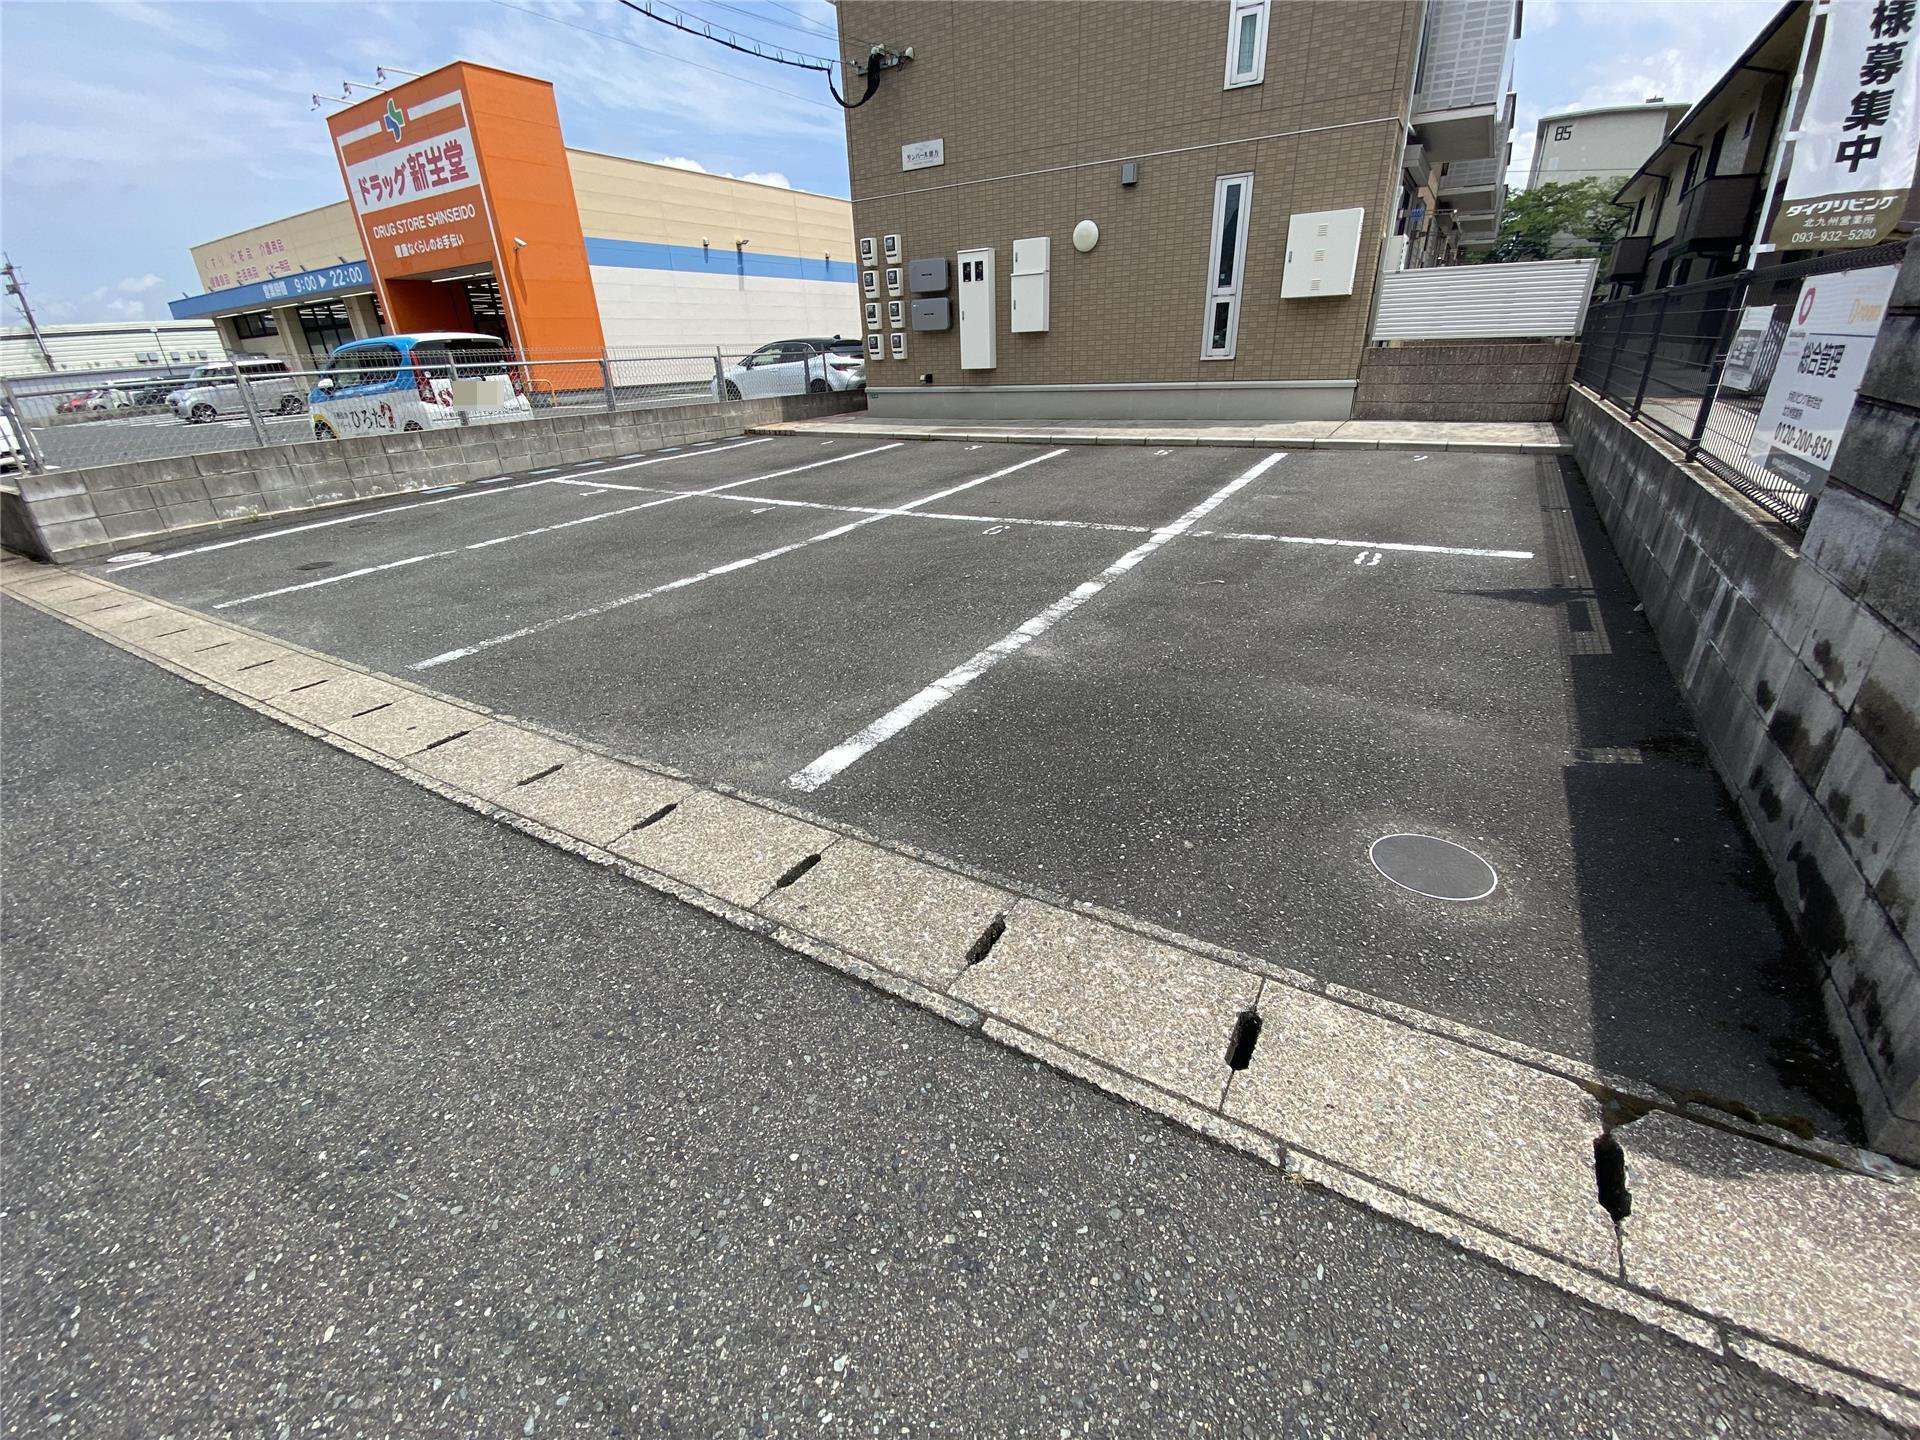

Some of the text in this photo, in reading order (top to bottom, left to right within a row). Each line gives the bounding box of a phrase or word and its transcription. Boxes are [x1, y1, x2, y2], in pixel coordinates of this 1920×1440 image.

[1835, 0, 1917, 173] 様募集中
[1554, 124, 1573, 142] 85
[358, 138, 470, 206] ドラッグ新生堂
[1785, 195, 1899, 217] ダイワリビング
[373, 203, 476, 239] DRUG STORE SHINSEIDO
[1803, 213, 1876, 228] 北九州営業所
[394, 233, 465, 258] なくらしのお手伝い
[1791, 228, 1877, 243] 093-932-5280
[294, 275, 317, 293] 9:00
[329, 266, 363, 287] 22:00
[1797, 340, 1846, 379] 総合管理
[350, 408, 386, 429] ひろた
[1774, 421, 1833, 461] 0120-200-850
